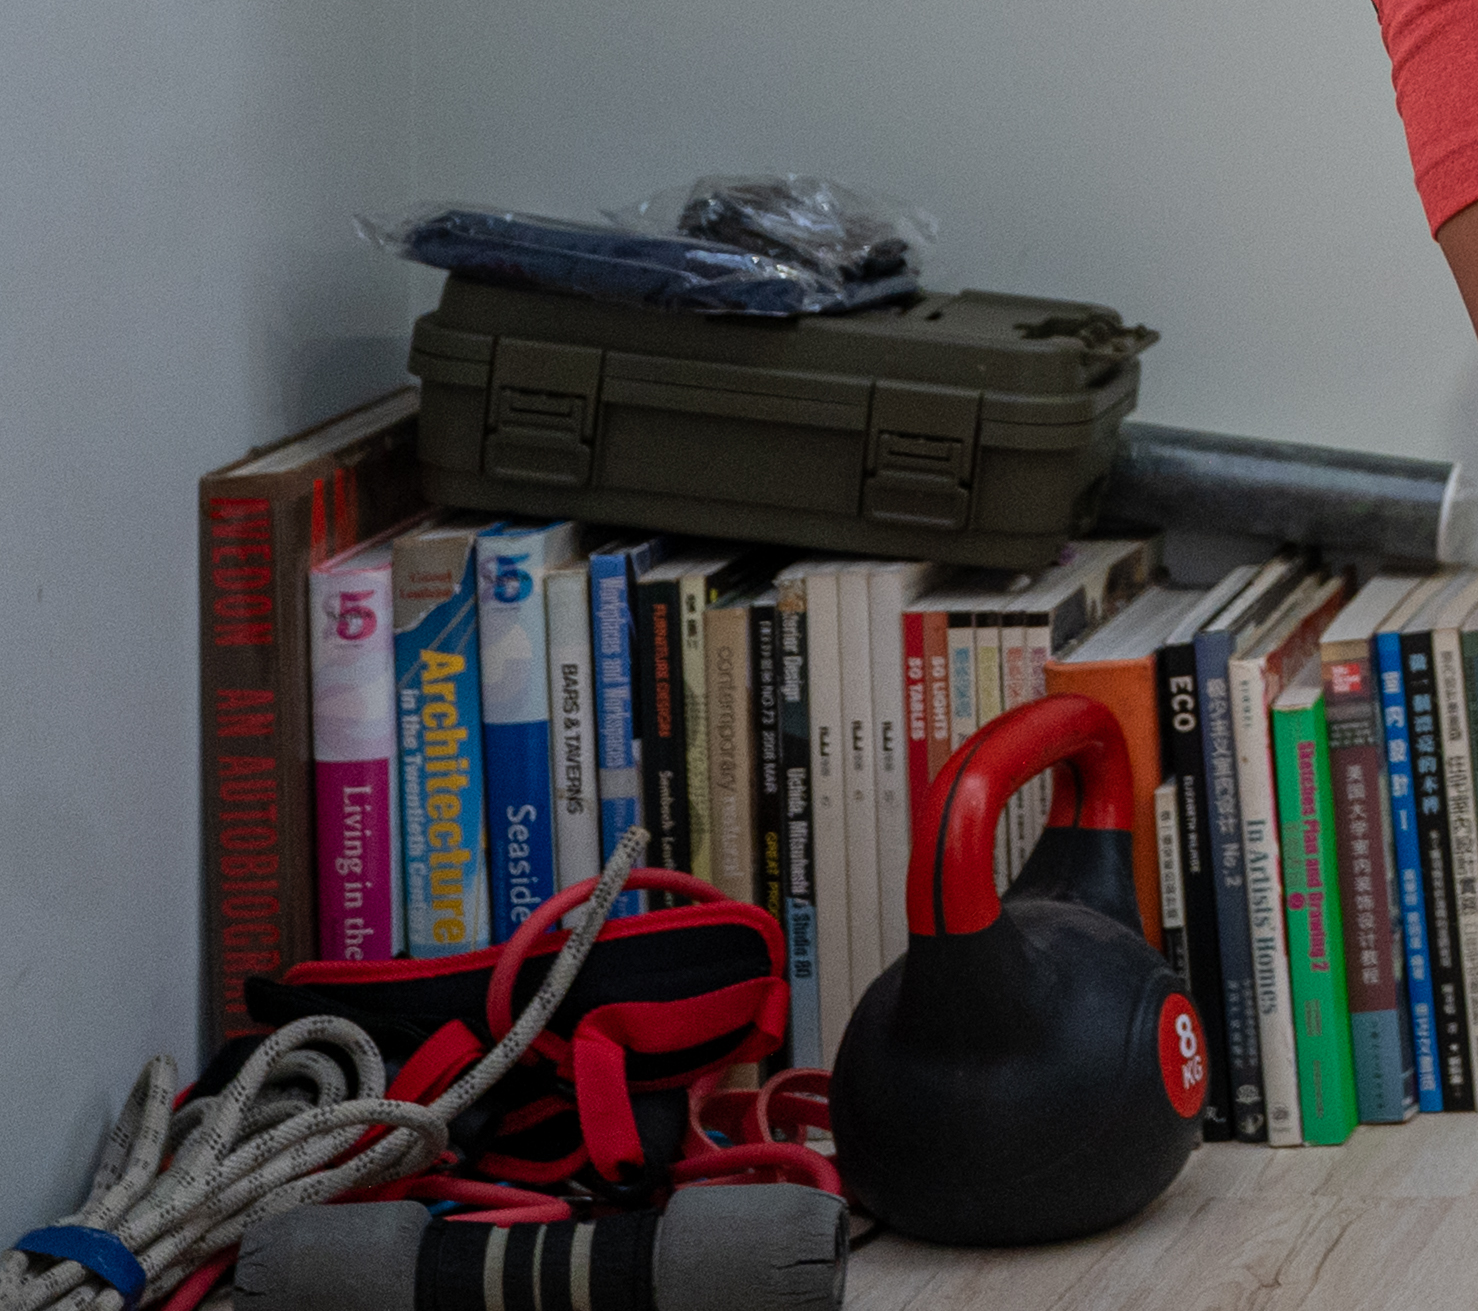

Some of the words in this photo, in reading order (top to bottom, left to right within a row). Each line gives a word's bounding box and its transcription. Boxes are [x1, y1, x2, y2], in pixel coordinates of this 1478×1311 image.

[216, 687, 277, 738] AN
[562, 663, 579, 713] BARS
[714, 645, 740, 792] contemporary
[1168, 674, 1196, 734] ECO
[419, 649, 469, 945] Architecture
[563, 734, 585, 815] TAVERNS
[335, 785, 371, 877] Living
[507, 804, 539, 923] Seaside
[344, 880, 368, 911] in
[345, 916, 370, 961] the
[1256, 937, 1280, 1016] Homes
[1175, 1013, 1197, 1058] 8
